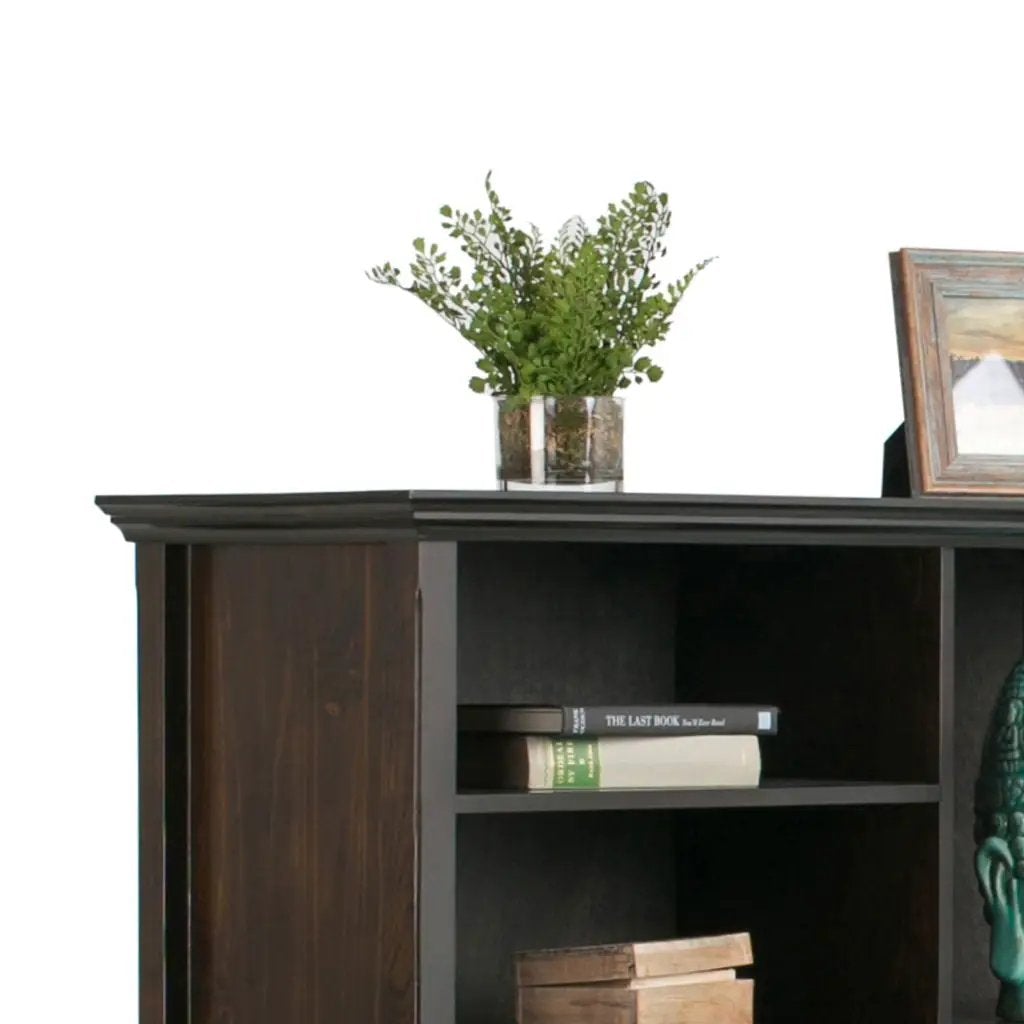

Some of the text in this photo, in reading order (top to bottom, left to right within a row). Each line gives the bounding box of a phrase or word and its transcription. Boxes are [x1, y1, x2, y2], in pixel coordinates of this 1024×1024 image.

[606, 714, 626, 727] THE
[628, 715, 652, 727] LAST
[654, 715, 680, 727] BOOK
